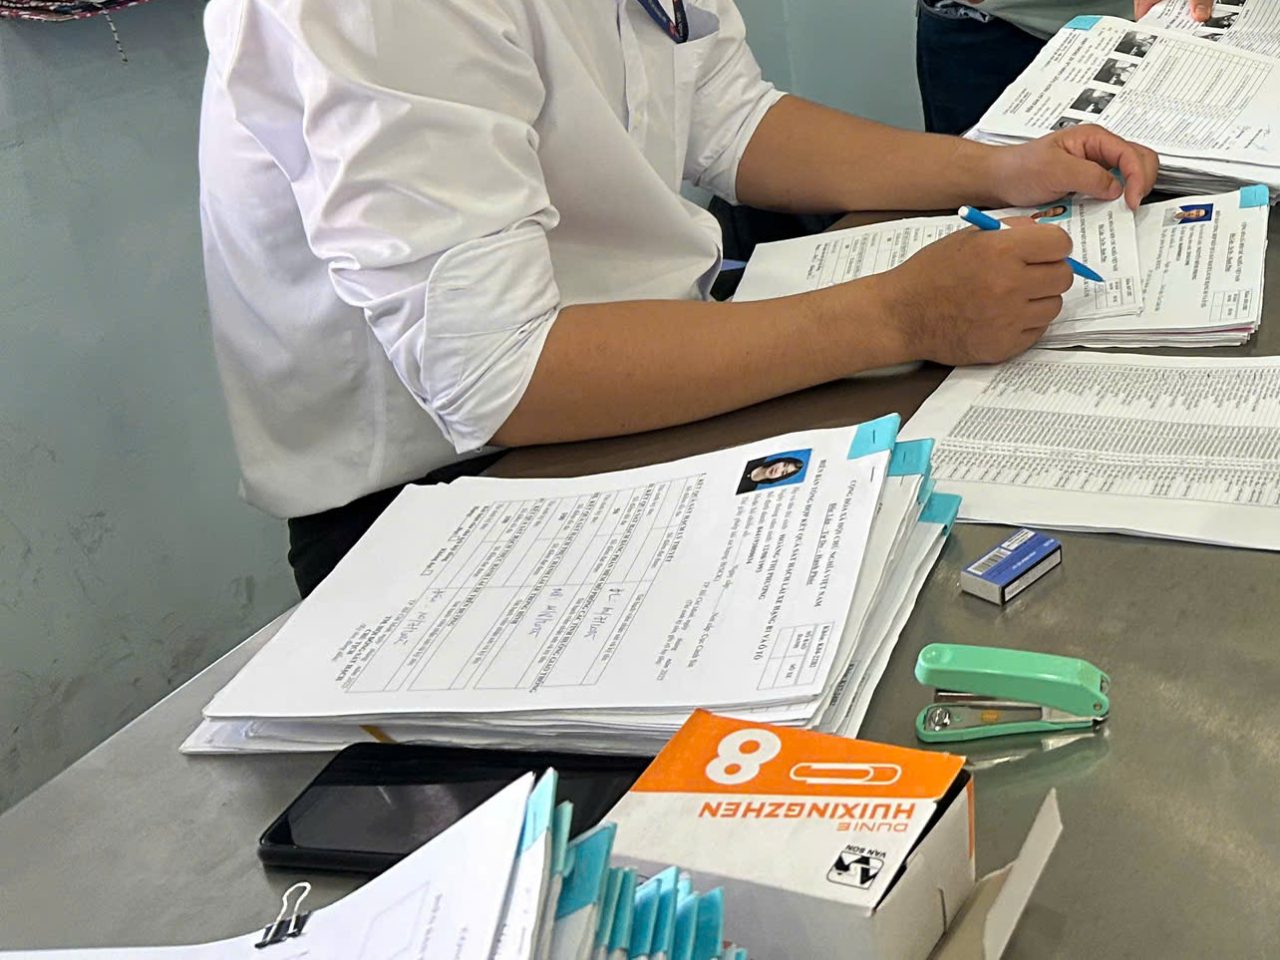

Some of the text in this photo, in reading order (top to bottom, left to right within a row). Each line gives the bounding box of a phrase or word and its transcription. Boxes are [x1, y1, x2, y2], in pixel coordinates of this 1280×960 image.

[705, 728, 782, 785] 8
[698, 802, 915, 819] HUIXINGZHEN
[837, 822, 908, 832] DUNIE
[866, 847, 887, 858] VAN
